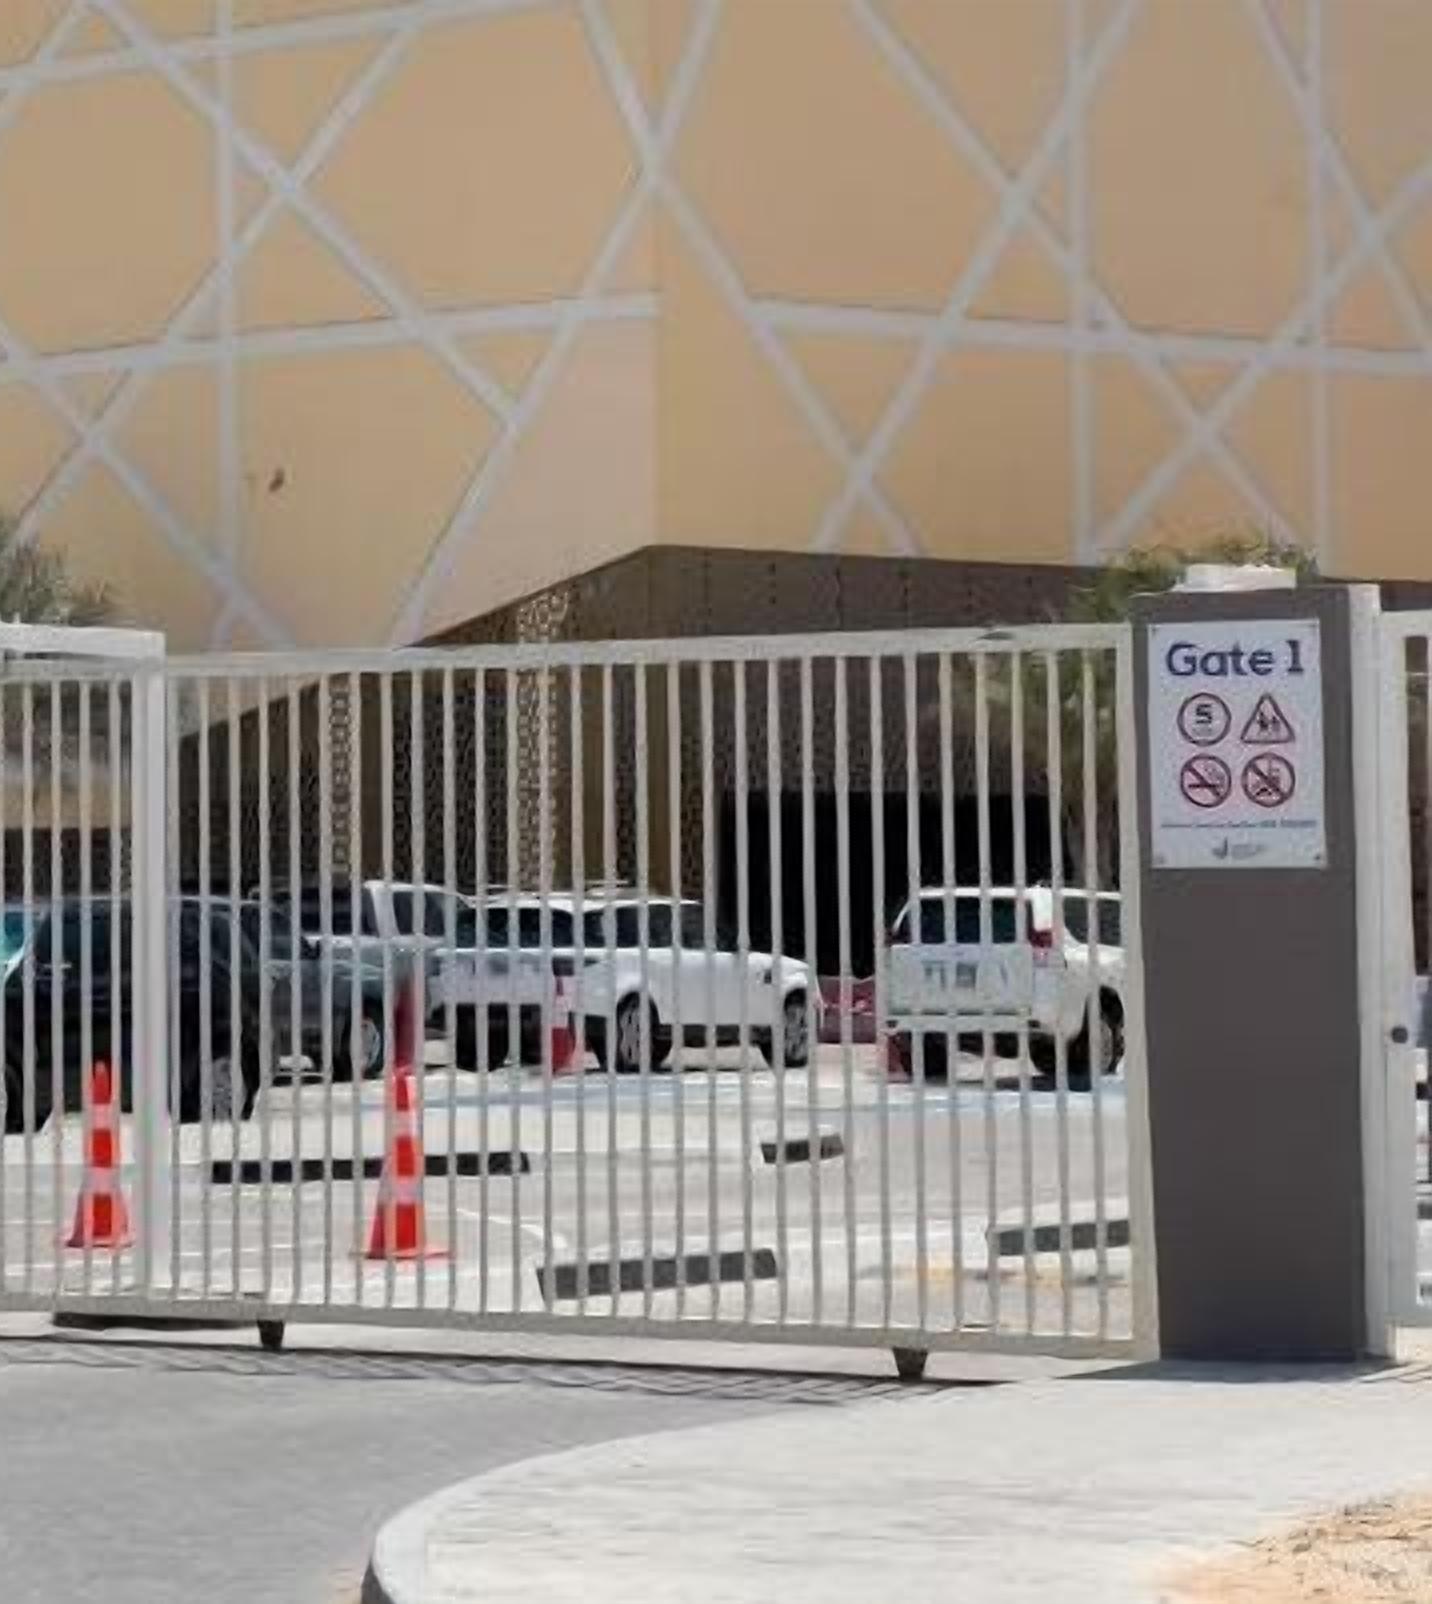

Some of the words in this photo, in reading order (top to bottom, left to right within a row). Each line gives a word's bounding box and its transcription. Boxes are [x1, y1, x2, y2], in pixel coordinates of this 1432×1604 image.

[1166, 641, 1275, 677] Gate
[1285, 639, 1304, 674] 1
[1195, 704, 1214, 724] 5
